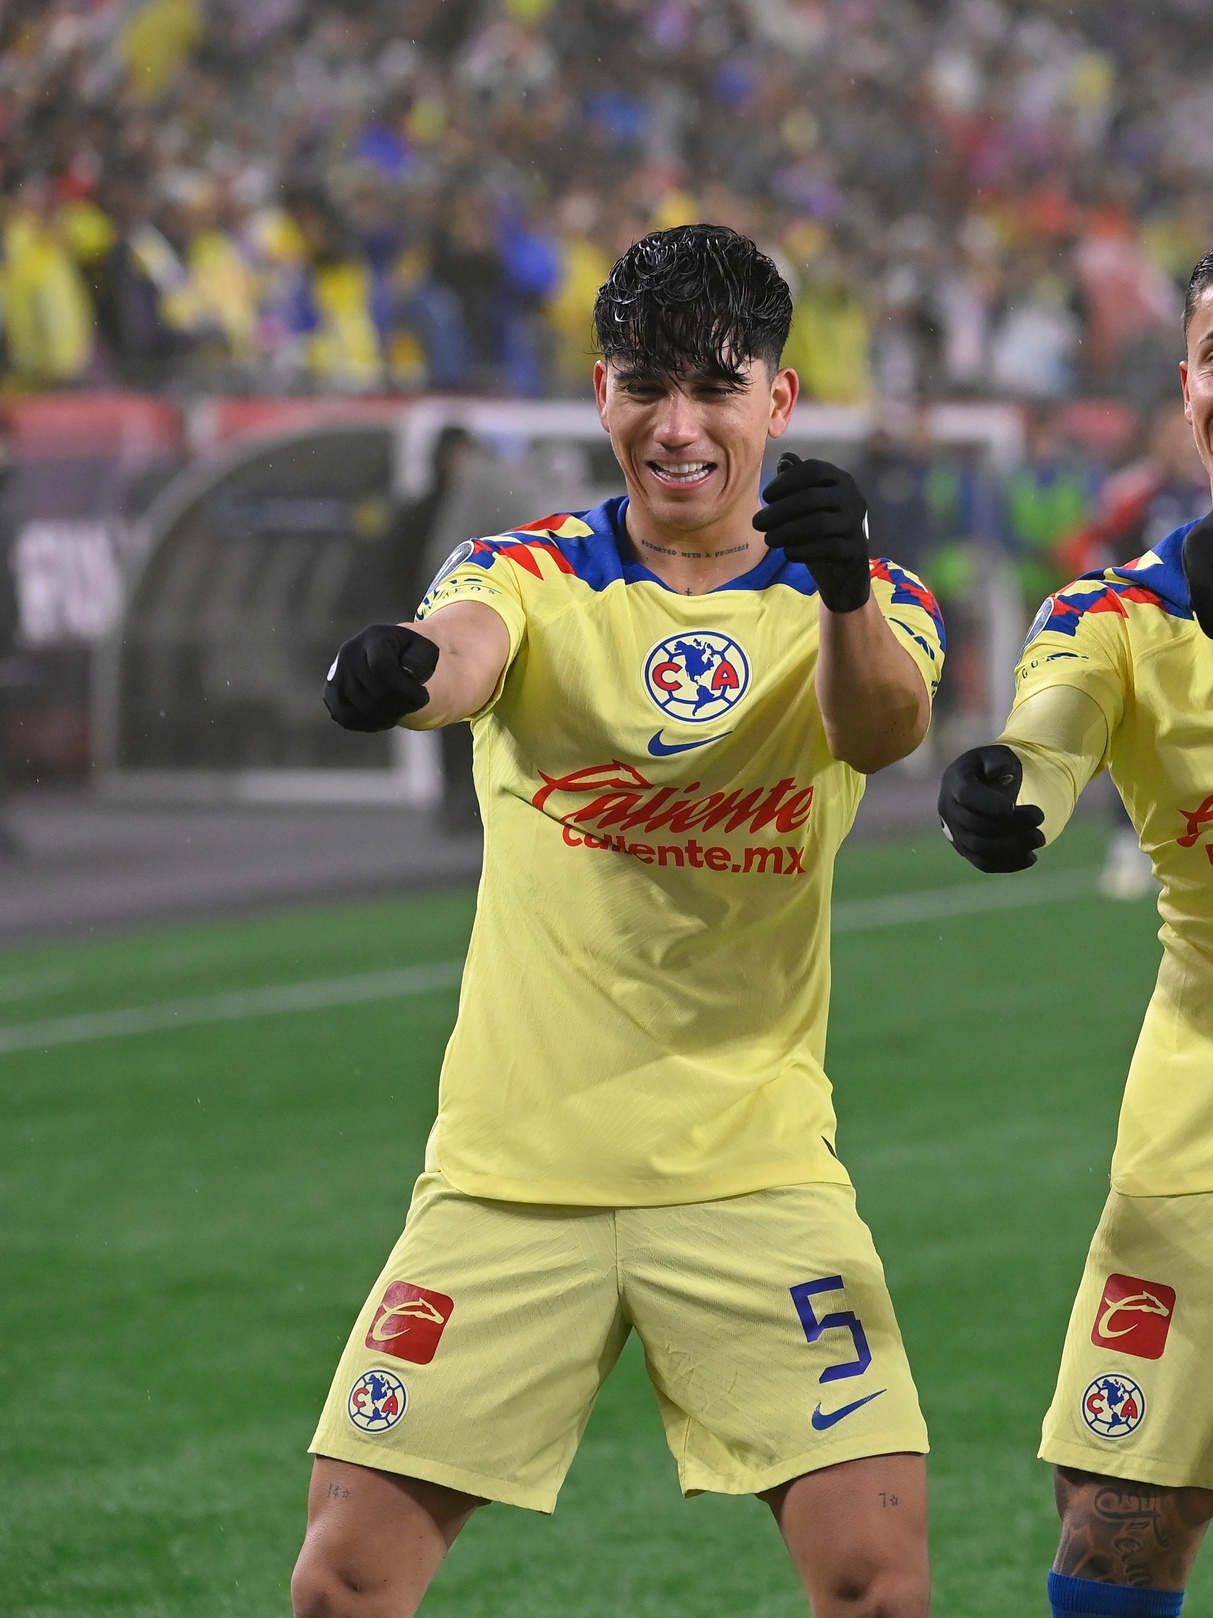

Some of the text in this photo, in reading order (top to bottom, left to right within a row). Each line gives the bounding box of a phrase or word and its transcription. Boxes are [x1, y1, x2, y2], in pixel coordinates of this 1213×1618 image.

[652, 660, 740, 691] C A
[531, 759, 815, 834] Caliente
[789, 1275, 873, 1384] 5
[352, 1386, 399, 1416] C A
[1086, 1392, 1138, 1419] C A
